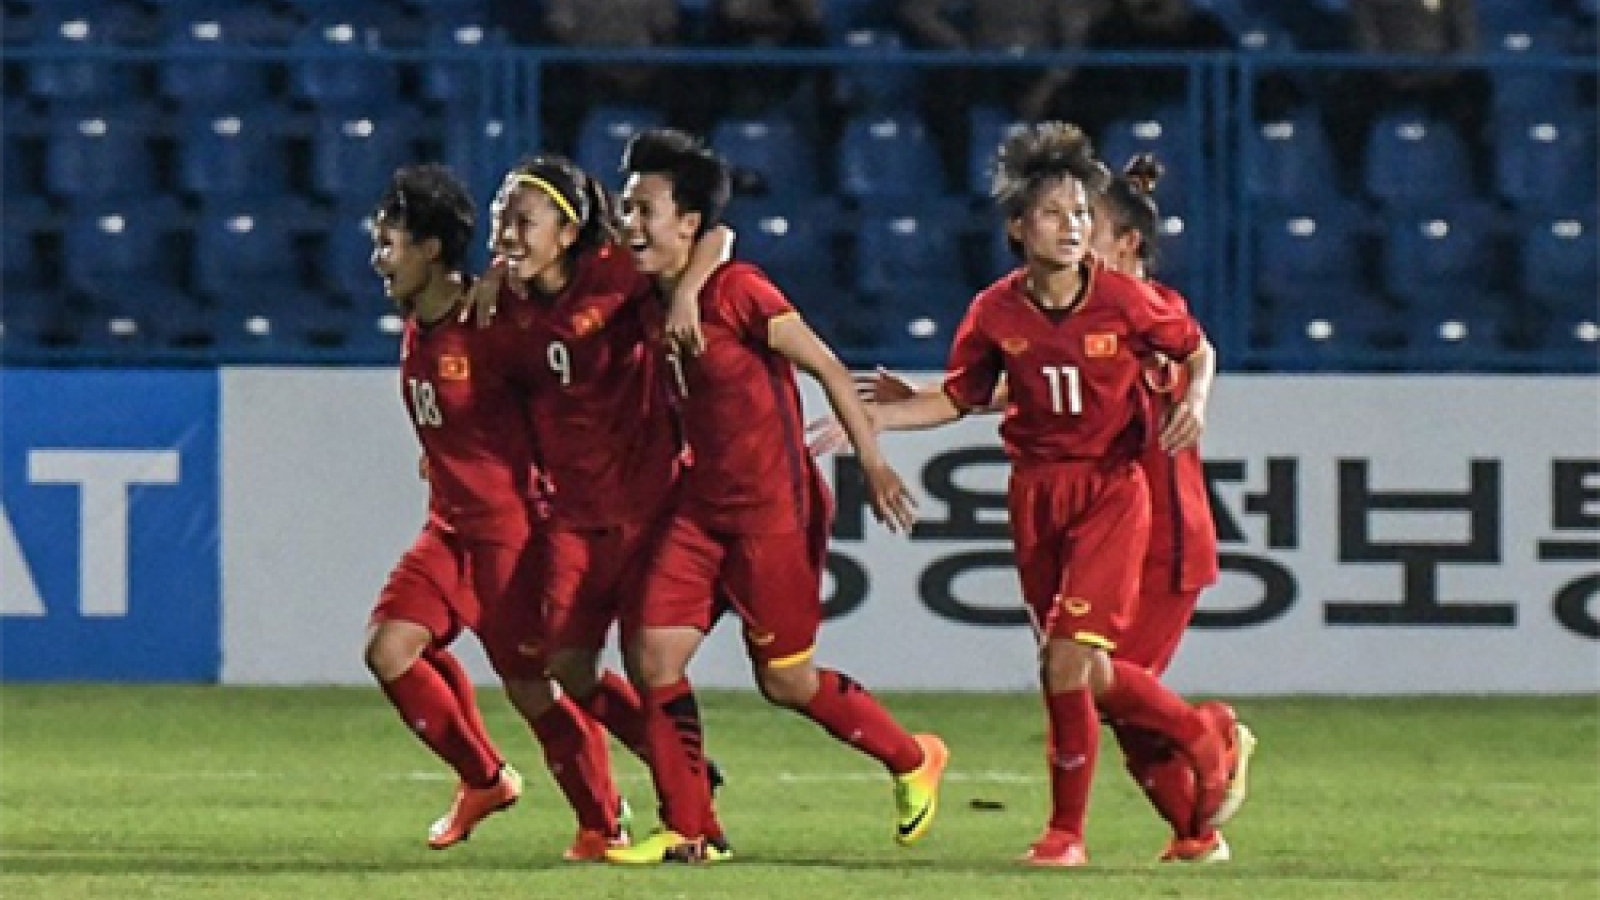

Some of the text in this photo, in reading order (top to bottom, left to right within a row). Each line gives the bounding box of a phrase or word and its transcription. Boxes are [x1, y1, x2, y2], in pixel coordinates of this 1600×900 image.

[547, 341, 571, 386] 9
[407, 377, 442, 427] 18
[1041, 365, 1083, 416] 11
